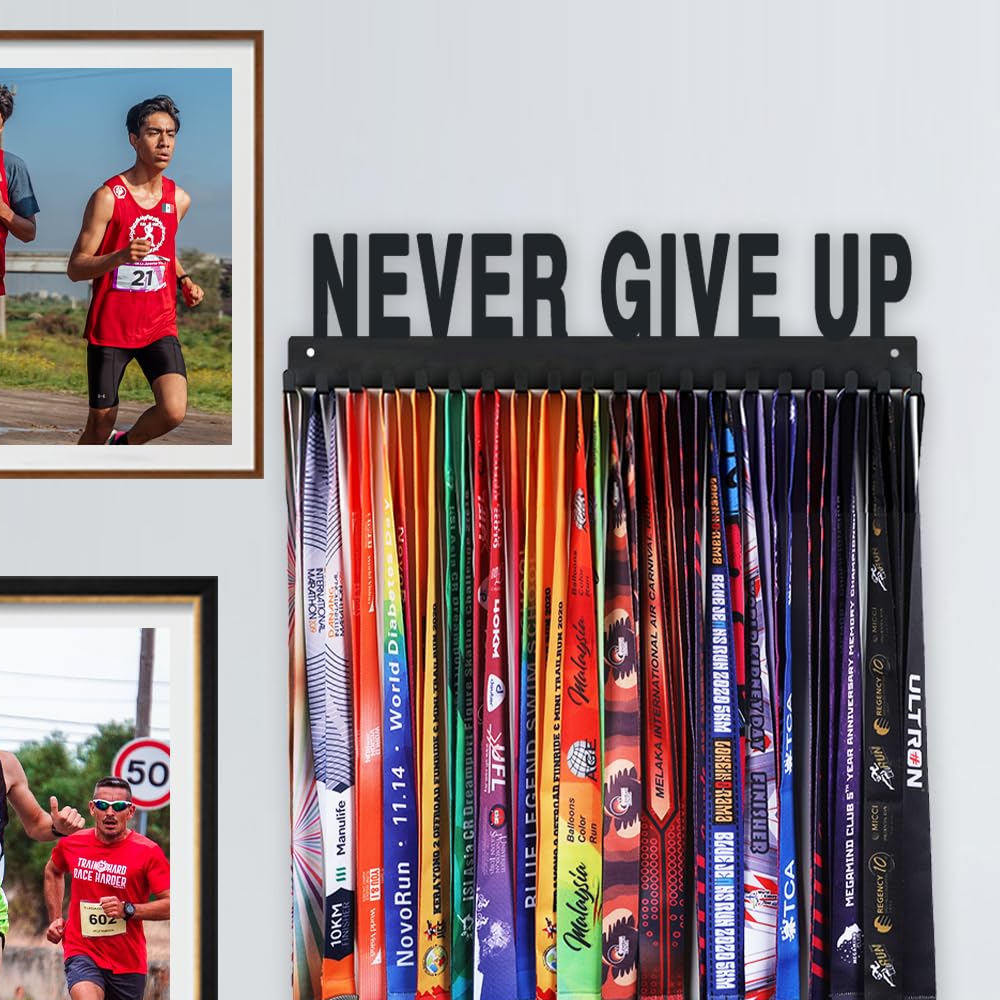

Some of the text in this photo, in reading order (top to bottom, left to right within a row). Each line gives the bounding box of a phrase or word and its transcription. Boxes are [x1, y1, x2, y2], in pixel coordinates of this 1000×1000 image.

[131, 270, 153, 286] 21
[313, 230, 912, 341] NEVER GIVE UP
[647, 533, 656, 600] CARNIVAL
[308, 568, 317, 619] MARATHON
[383, 498, 404, 731] World Diabetes Day
[648, 604, 657, 628] AIR
[491, 599, 500, 658] 40KM
[847, 600, 855, 655] MEMORY
[567, 616, 591, 706] Malaysia
[650, 632, 664, 738] INTERNATIONAL
[750, 644, 764, 713] KIDNEY
[873, 658, 884, 675] 10
[526, 662, 536, 732] SWIM
[846, 658, 855, 745] ANNIVERSARY
[750, 714, 764, 750] DAY
[906, 673, 923, 788] ULTRON
[127, 760, 169, 787] 50
[490, 745, 505, 792] UFL
[553, 734, 561, 783] FUNRIDE
[585, 738, 597, 782] AGE
[654, 741, 665, 799] MELAKA
[846, 748, 854, 781] YEAR
[871, 745, 889, 769] RUN
[433, 787, 441, 839] OFFROAD
[525, 744, 536, 838] LEGEND
[750, 771, 770, 855] FINISHER
[335, 800, 347, 856] Manulife
[463, 821, 474, 840] CR
[567, 797, 576, 843] Balloons
[578, 814, 587, 843] Color
[589, 823, 598, 844] Run
[845, 803, 854, 836] CLUB
[871, 804, 879, 831] MICCI
[391, 766, 414, 967] NovoRun 11.14
[433, 840, 441, 848] 2
[463, 844, 474, 876] Asia
[73, 868, 127, 888] RACE HARDER
[107, 863, 127, 875] HARD
[463, 880, 474, 901] ISI
[525, 847, 536, 909] BLUE
[783, 859, 796, 918] TCA
[845, 839, 854, 907] MEGAMIND
[872, 856, 887, 914] REGENCY 10
[89, 912, 117, 925] 602
[330, 903, 343, 948] 10KM
[341, 900, 351, 947] FINISHER
[562, 862, 595, 952] Malaysia
[369, 907, 377, 958] World Vision
[871, 943, 890, 967] RUN
